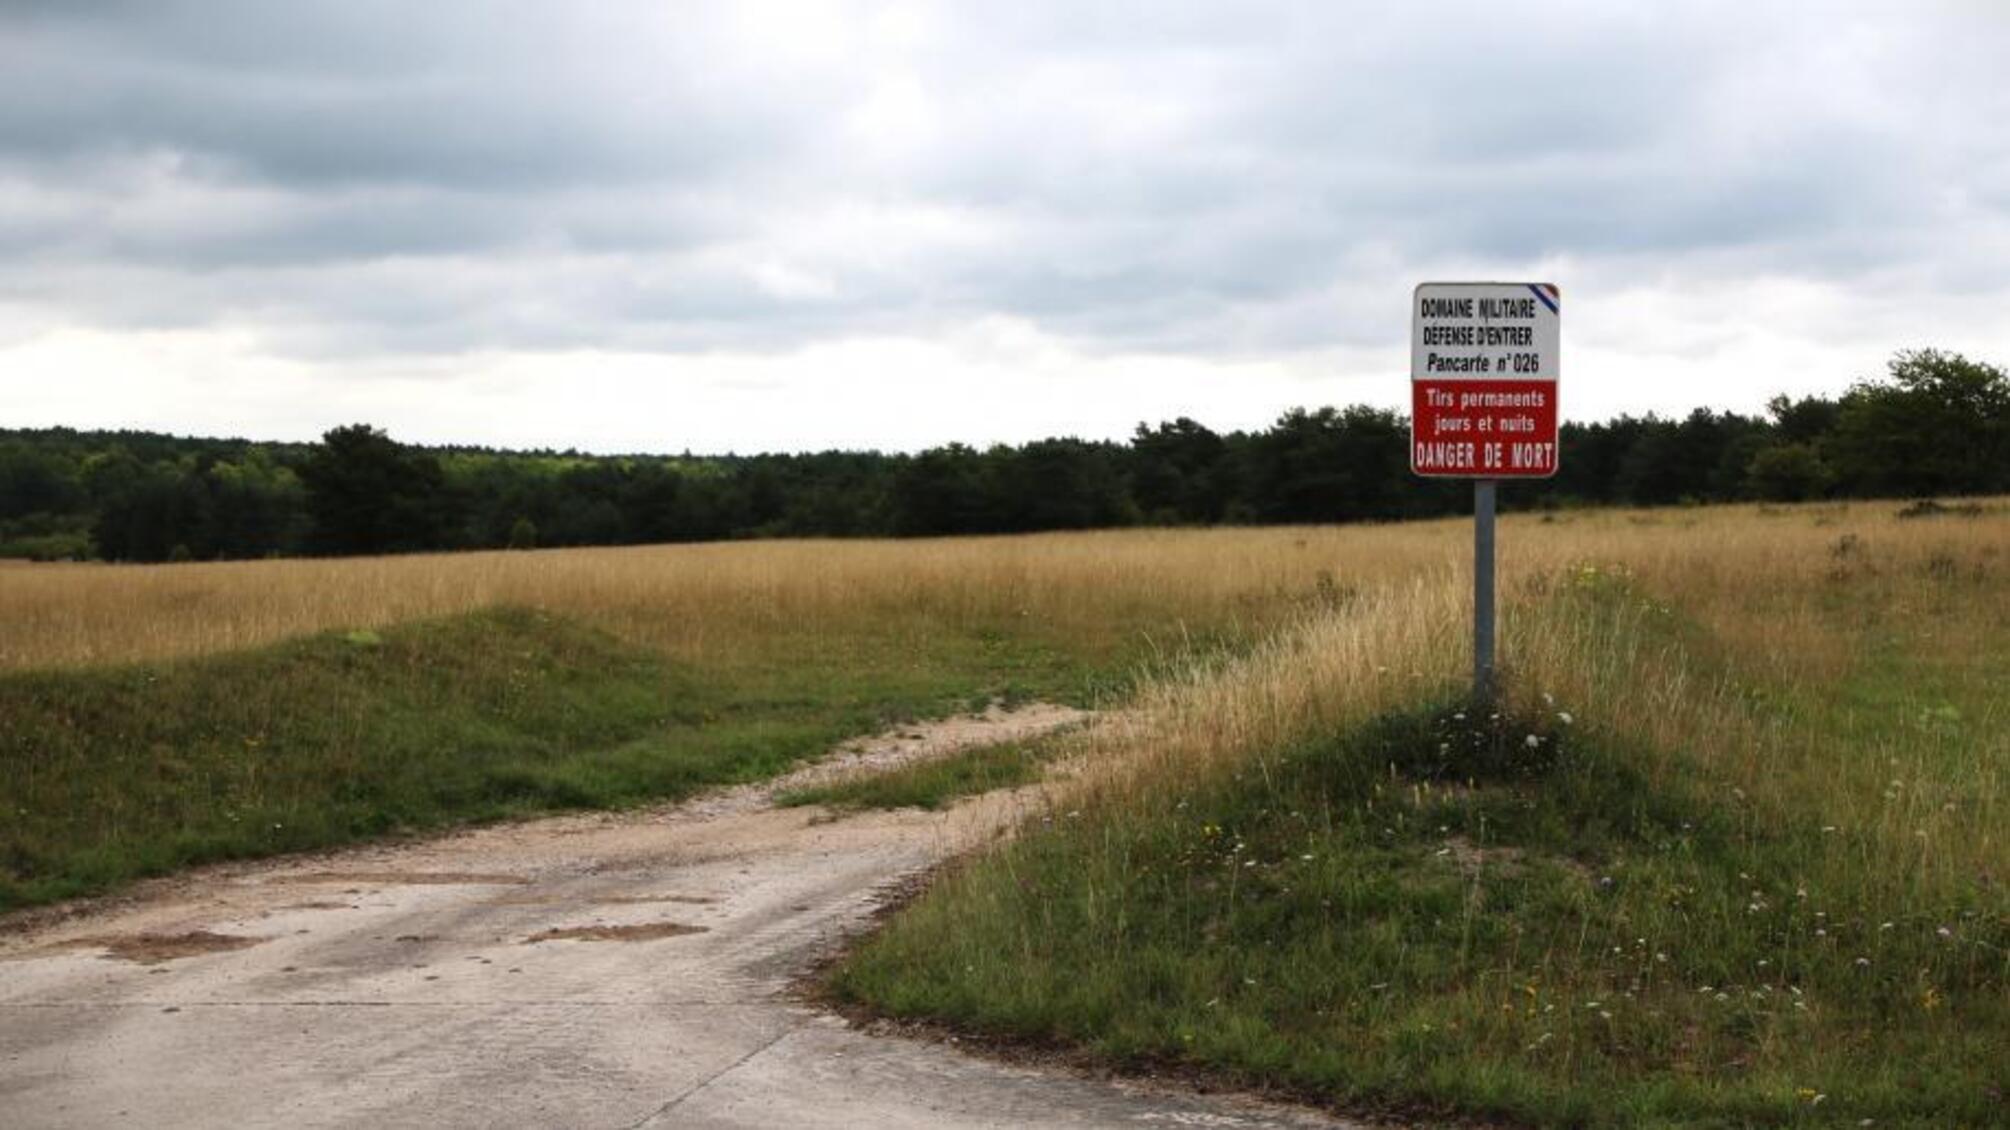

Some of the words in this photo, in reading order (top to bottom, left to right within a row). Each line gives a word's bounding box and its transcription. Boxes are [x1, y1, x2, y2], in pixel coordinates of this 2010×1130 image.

[1421, 298, 1473, 318] DOMAINE
[1479, 298, 1535, 318] MILITAIRE
[1477, 326, 1532, 345] D'ENTRER
[1427, 353, 1489, 372] Pancarte
[1426, 388, 1454, 407] Tirs
[1460, 391, 1545, 411] permanents
[1434, 414, 1471, 436] jours
[1478, 415, 1493, 431] et
[1500, 414, 1535, 431] nuits
[1416, 442, 1475, 468] DANGER
[1484, 442, 1503, 468] DE
[1511, 442, 1553, 468] MORT
